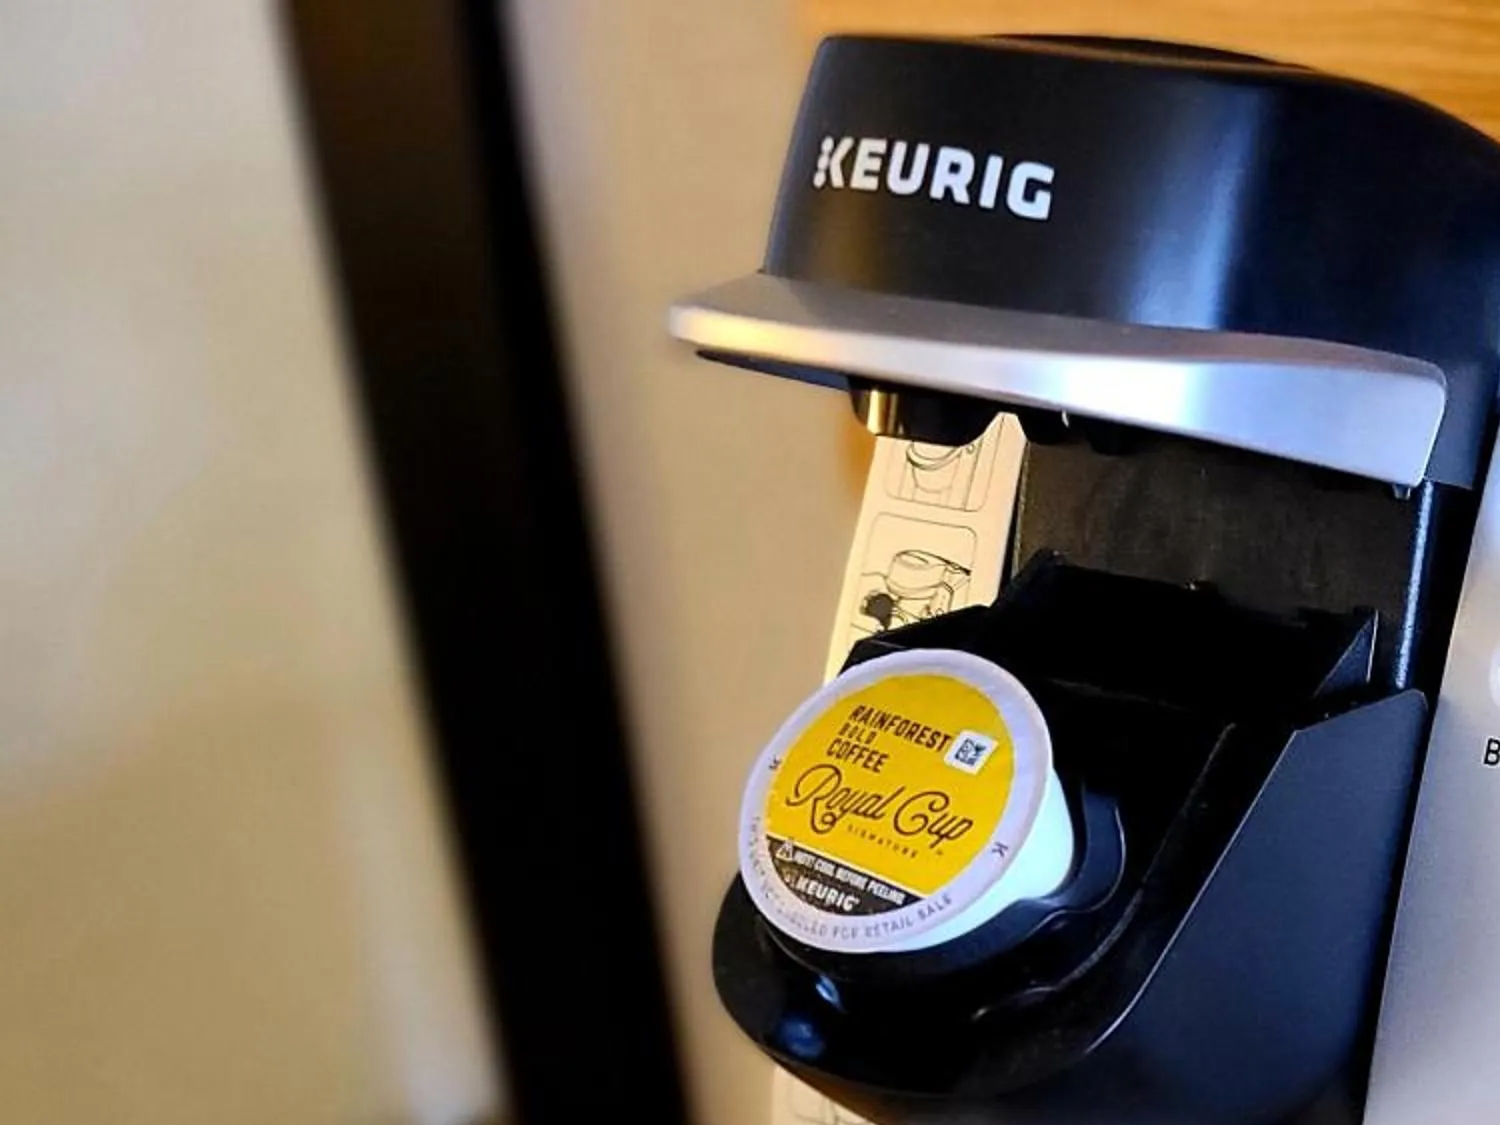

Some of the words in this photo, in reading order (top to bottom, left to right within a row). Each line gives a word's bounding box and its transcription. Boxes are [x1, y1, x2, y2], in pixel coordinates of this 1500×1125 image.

[812, 135, 1055, 220] KEURIG
[838, 722, 878, 745] BOLD
[849, 704, 952, 752] RAINFOREST
[826, 737, 889, 774] COFFEE
[785, 764, 907, 835] Royal
[893, 791, 974, 849] Cup
[864, 916, 914, 938] RETAIL
[918, 893, 952, 918] SALE
